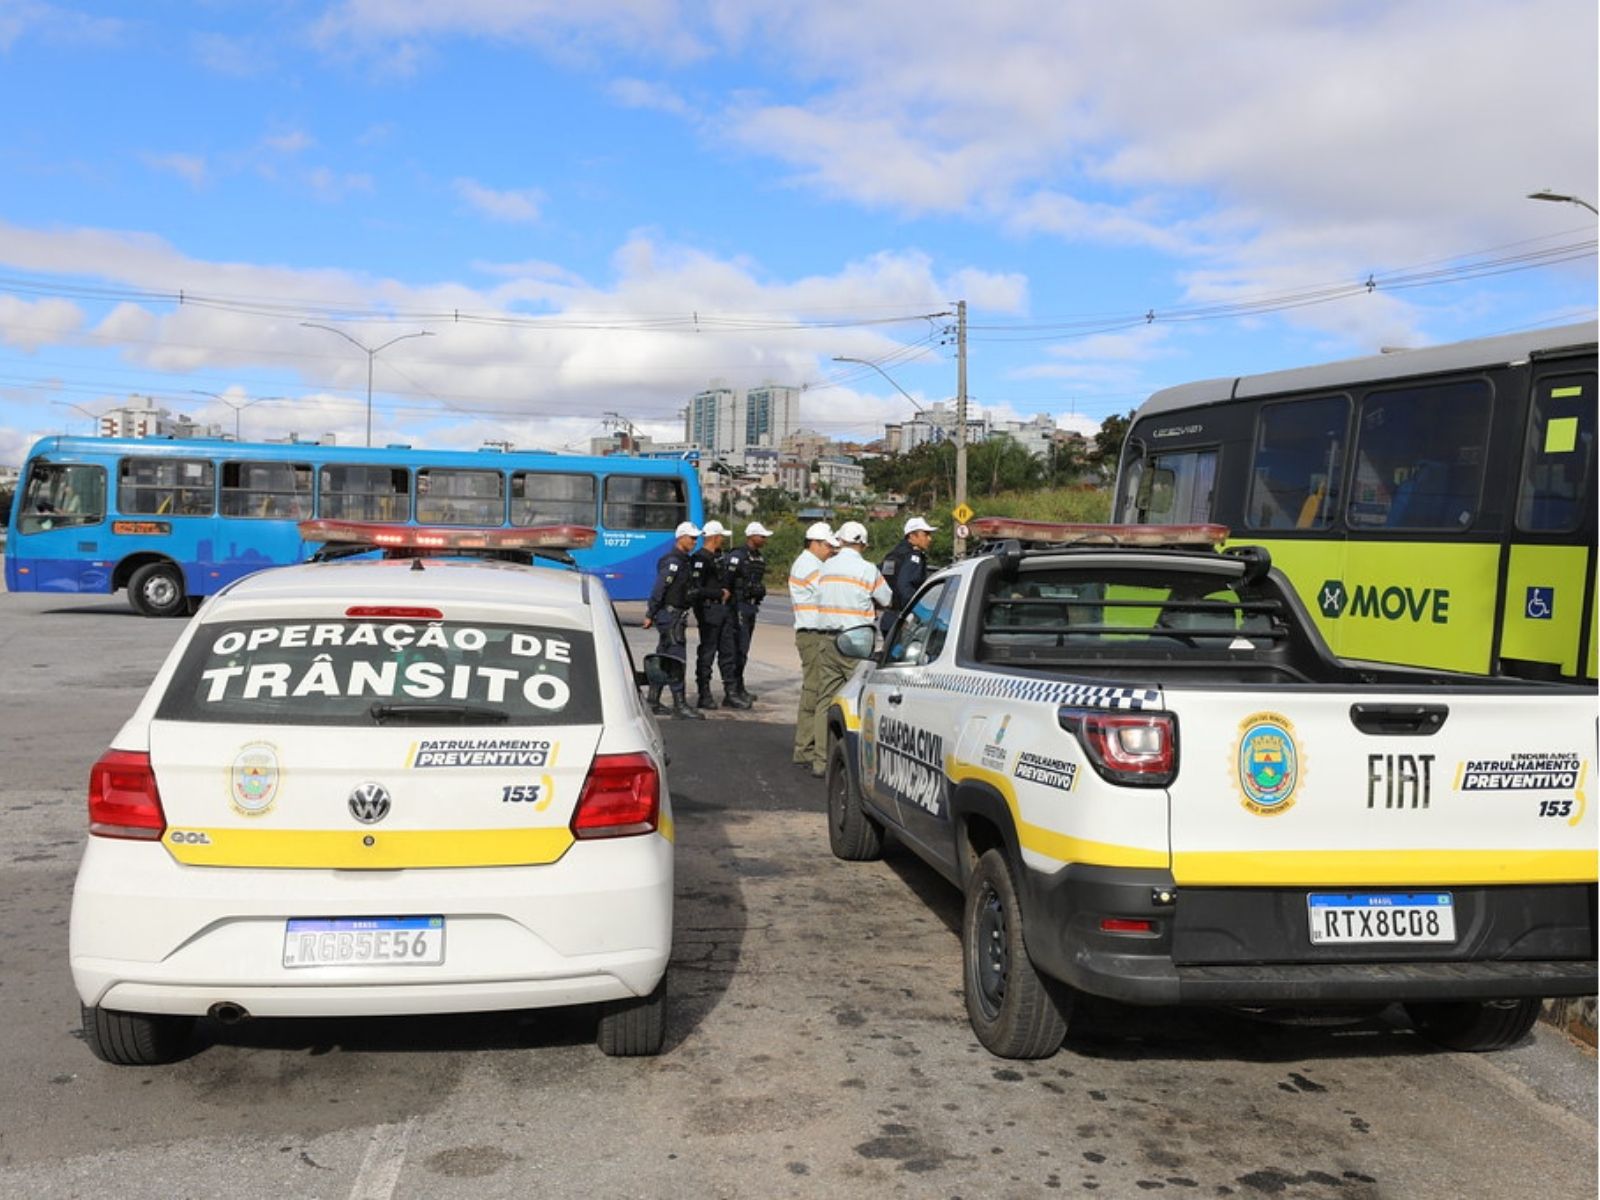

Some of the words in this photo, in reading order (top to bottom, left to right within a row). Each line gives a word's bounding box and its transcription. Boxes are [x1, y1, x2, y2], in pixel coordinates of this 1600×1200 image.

[604, 538, 630, 547] 10727
[1349, 584, 1450, 624] MOVE
[212, 622, 488, 655] OPERAÇÃO
[510, 633, 571, 664] DE
[201, 653, 571, 711] TRÂNSITO
[419, 740, 551, 750] PATRULHAMENTO
[879, 714, 917, 758] GUARDA
[917, 727, 943, 769] CIVIL
[419, 752, 544, 765] PREVENTIVO
[1019, 751, 1077, 774] PATRULHAMENTO
[1466, 760, 1580, 771] PATRULHAMENTO
[1511, 752, 1579, 760] ENDURANCE
[877, 745, 941, 816] MUNICIPAL
[1016, 762, 1072, 788] PREVENTIVO
[1367, 754, 1436, 809] FIAT
[1466, 773, 1574, 788] PREVENTIVO
[502, 785, 540, 802] 153
[1539, 800, 1572, 817] 153
[171, 831, 210, 844] GOL
[1325, 909, 1440, 937] RTX8C08
[299, 931, 428, 962] RGB5E56
